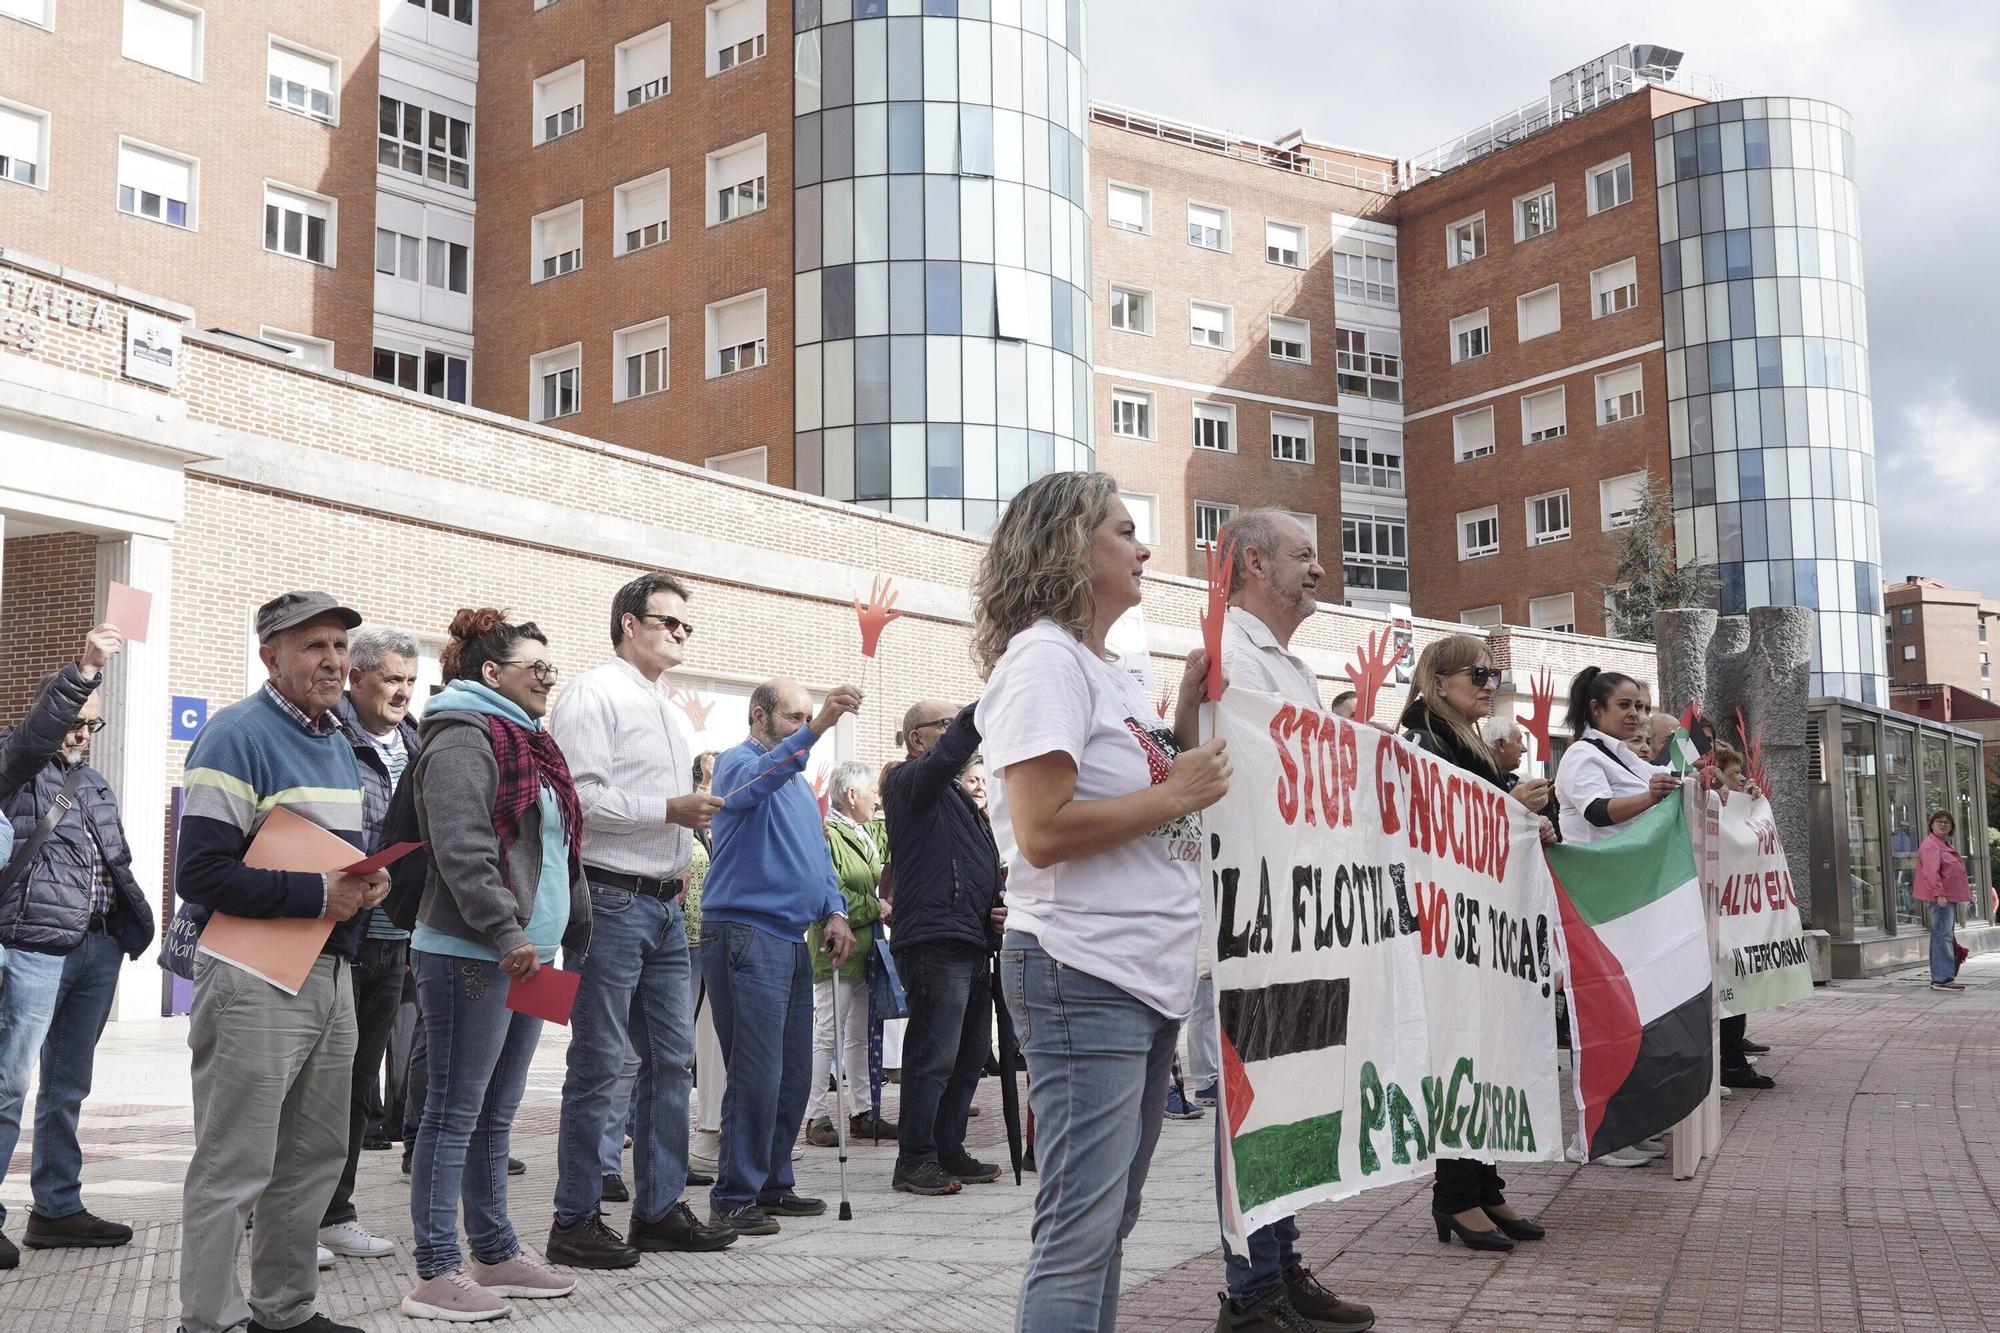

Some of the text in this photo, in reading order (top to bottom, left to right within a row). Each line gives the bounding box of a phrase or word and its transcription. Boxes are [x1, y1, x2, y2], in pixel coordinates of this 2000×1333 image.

[181, 709, 198, 729] C
[1269, 701, 1358, 830] STOP
[1719, 871, 1762, 917] ALTO
[1454, 891, 1481, 968] SE
[1488, 904, 1551, 999] TOCA!
